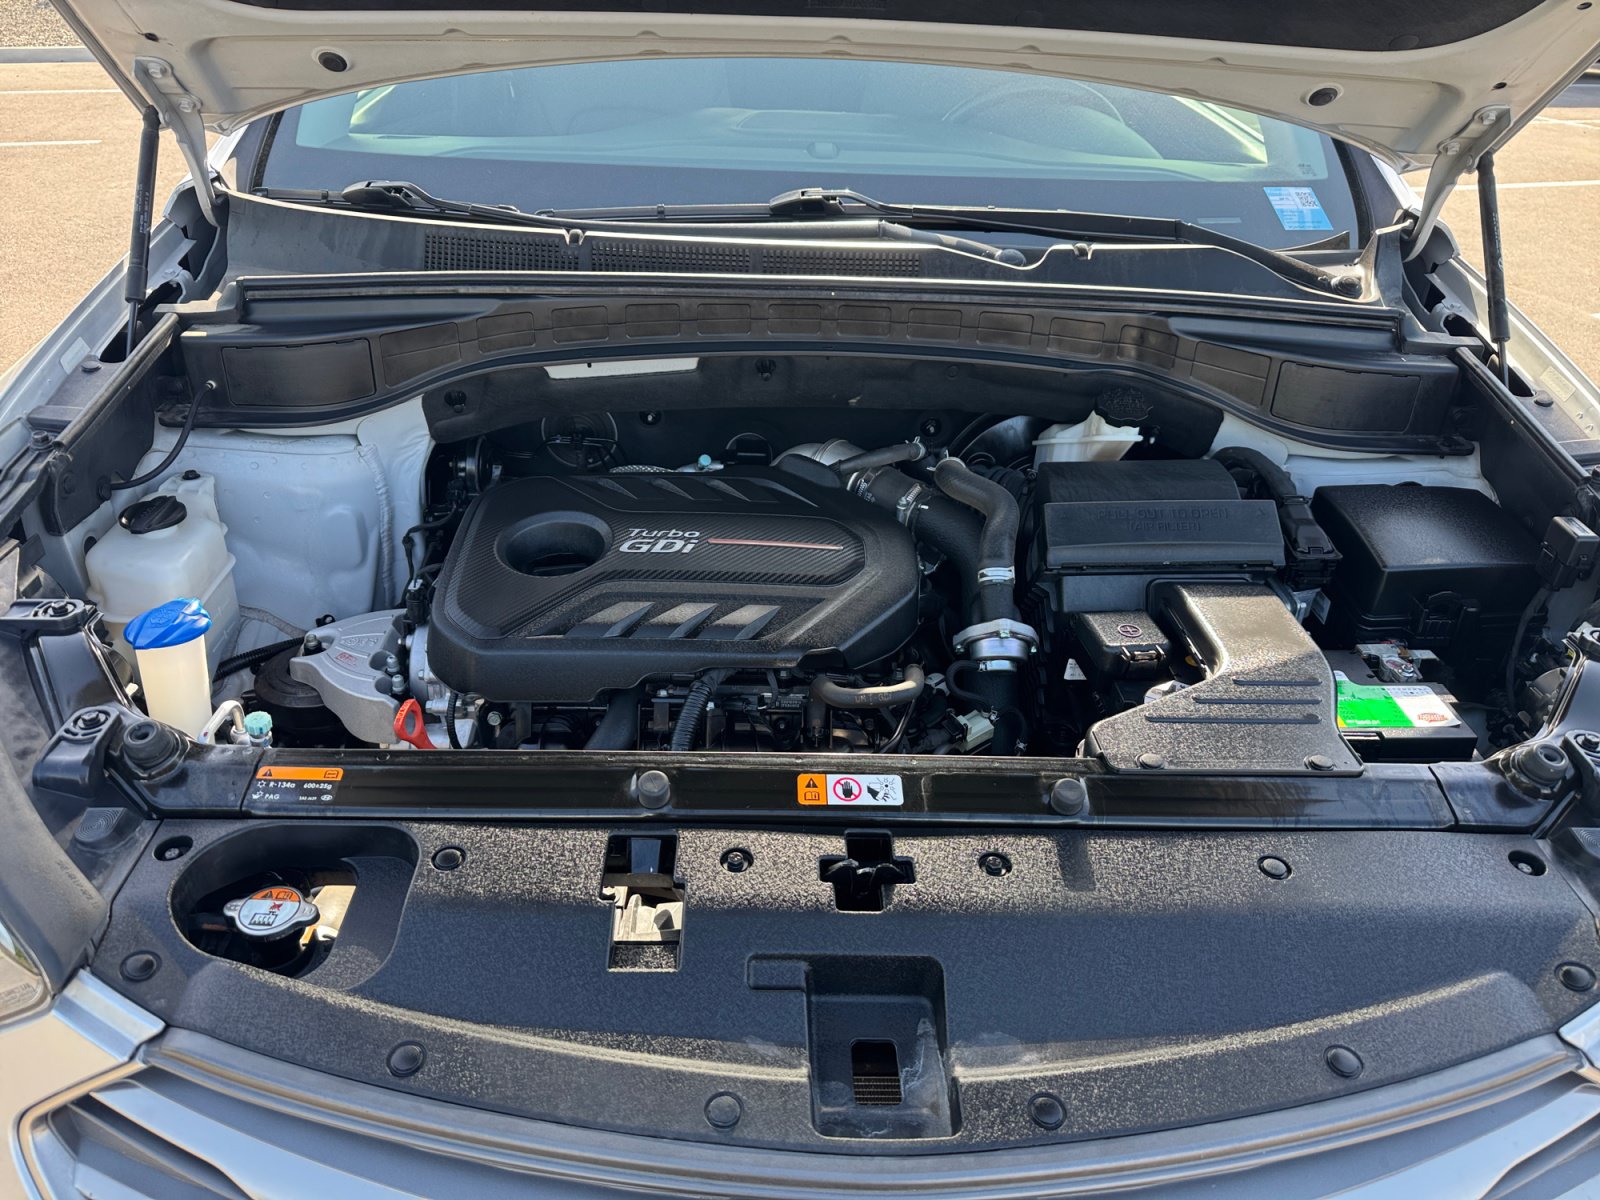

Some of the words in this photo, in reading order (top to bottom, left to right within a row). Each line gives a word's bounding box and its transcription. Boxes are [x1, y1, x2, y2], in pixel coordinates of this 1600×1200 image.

[628, 528, 700, 538] Turbo
[619, 539, 699, 553] GDi
[268, 781, 296, 789] R-134a
